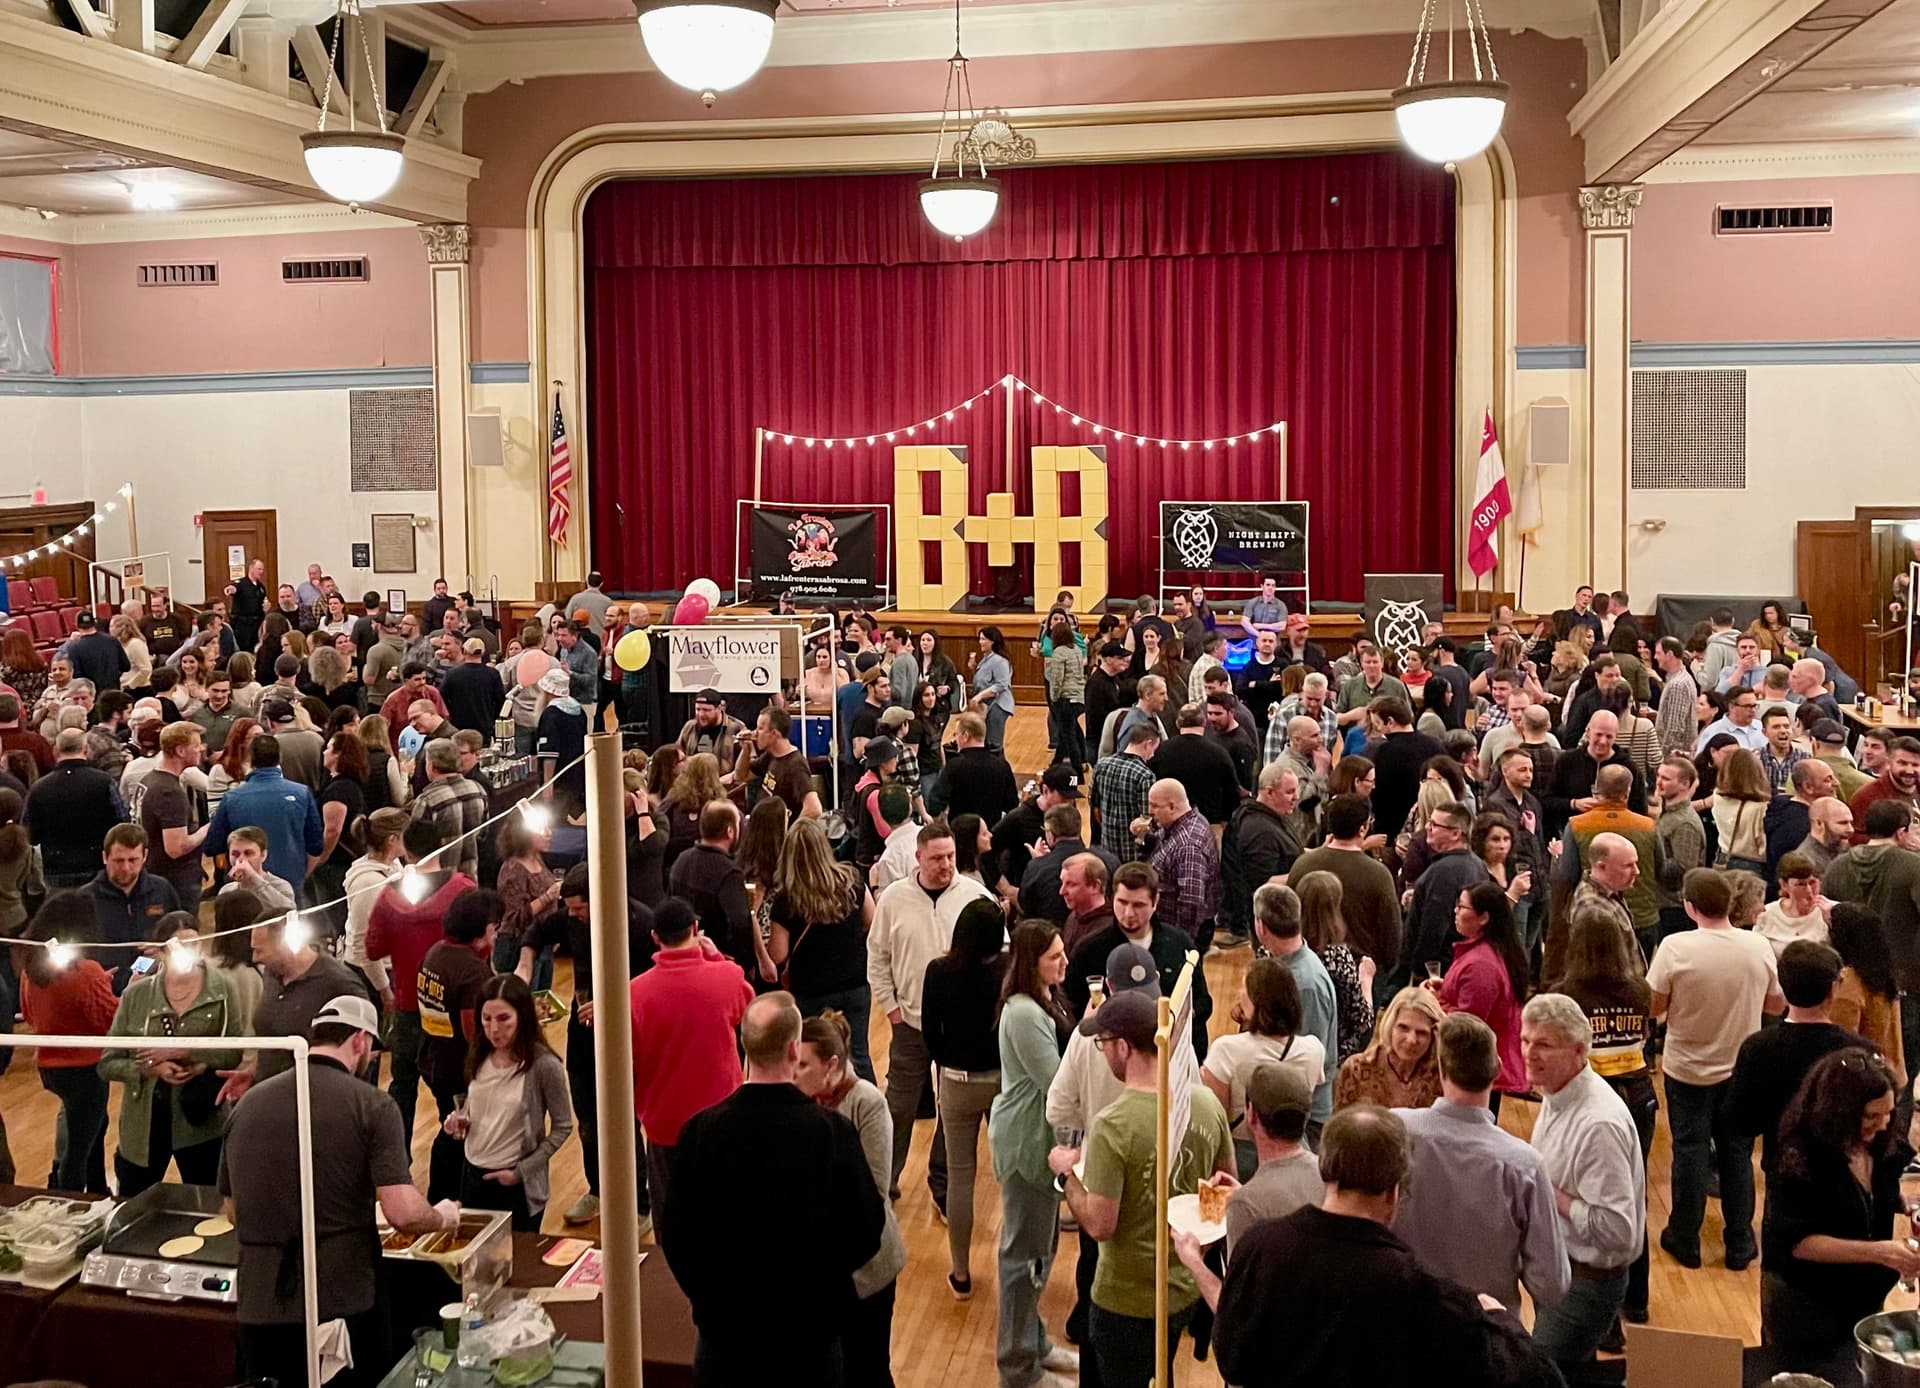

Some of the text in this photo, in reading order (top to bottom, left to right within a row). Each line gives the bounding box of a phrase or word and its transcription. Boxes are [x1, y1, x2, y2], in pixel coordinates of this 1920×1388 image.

[1474, 499, 1499, 531] 1900
[1228, 531, 1296, 539] NIGHT SHIFT
[1239, 541, 1286, 549] BREWING
[760, 573, 867, 585] www.lafronterasabrosa.com
[671, 635, 779, 660] Mayflower
[1590, 1016, 1607, 1032] EER
